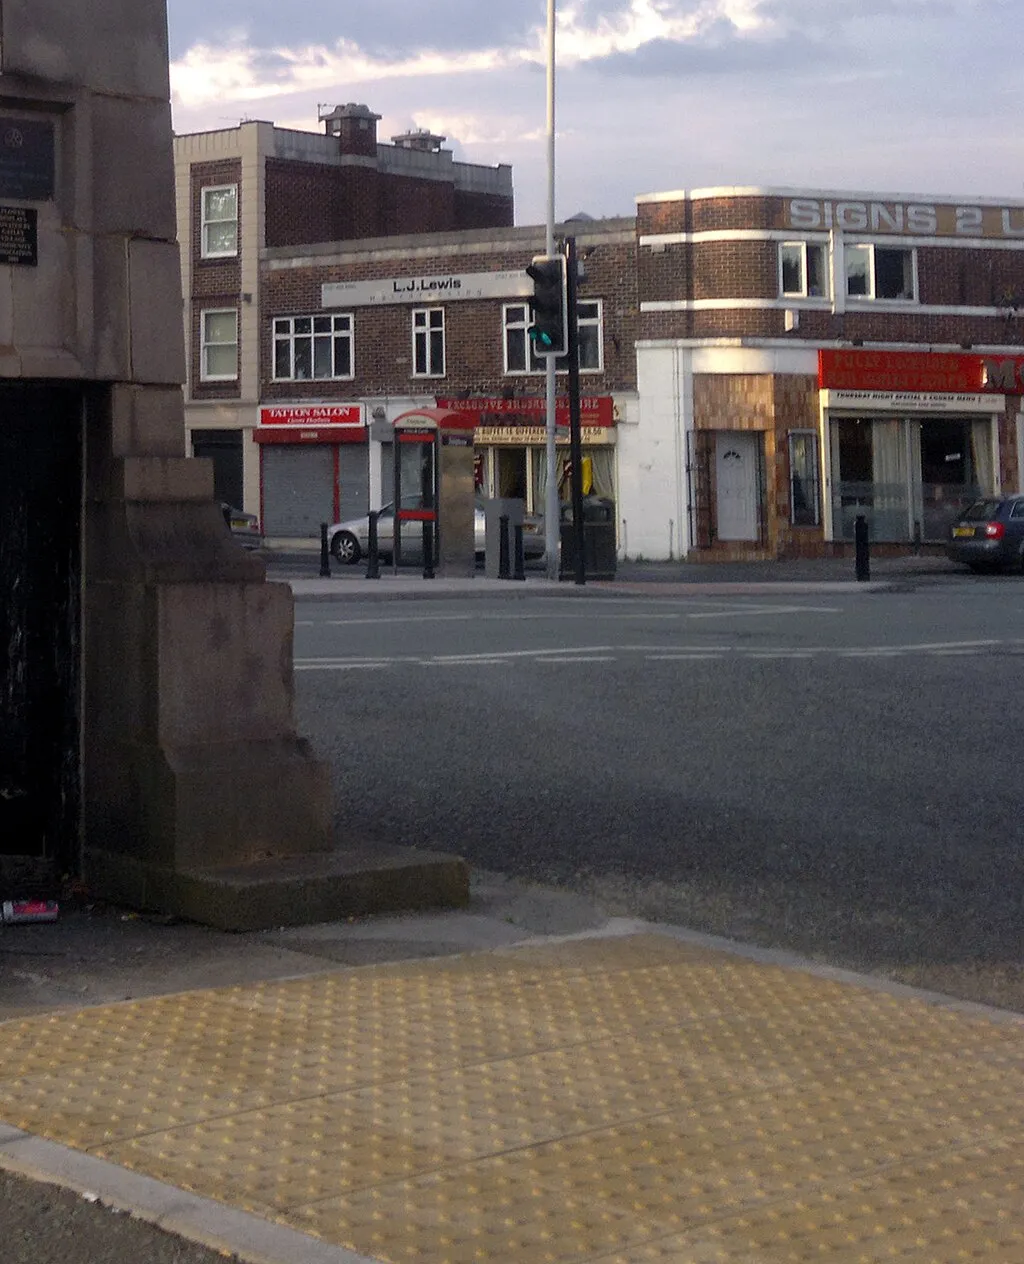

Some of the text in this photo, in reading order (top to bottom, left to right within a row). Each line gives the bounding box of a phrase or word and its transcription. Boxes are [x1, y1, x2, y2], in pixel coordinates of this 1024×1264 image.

[790, 199, 937, 234] SIGNS
[955, 207, 982, 234] 2
[313, 407, 351, 417] SALON
